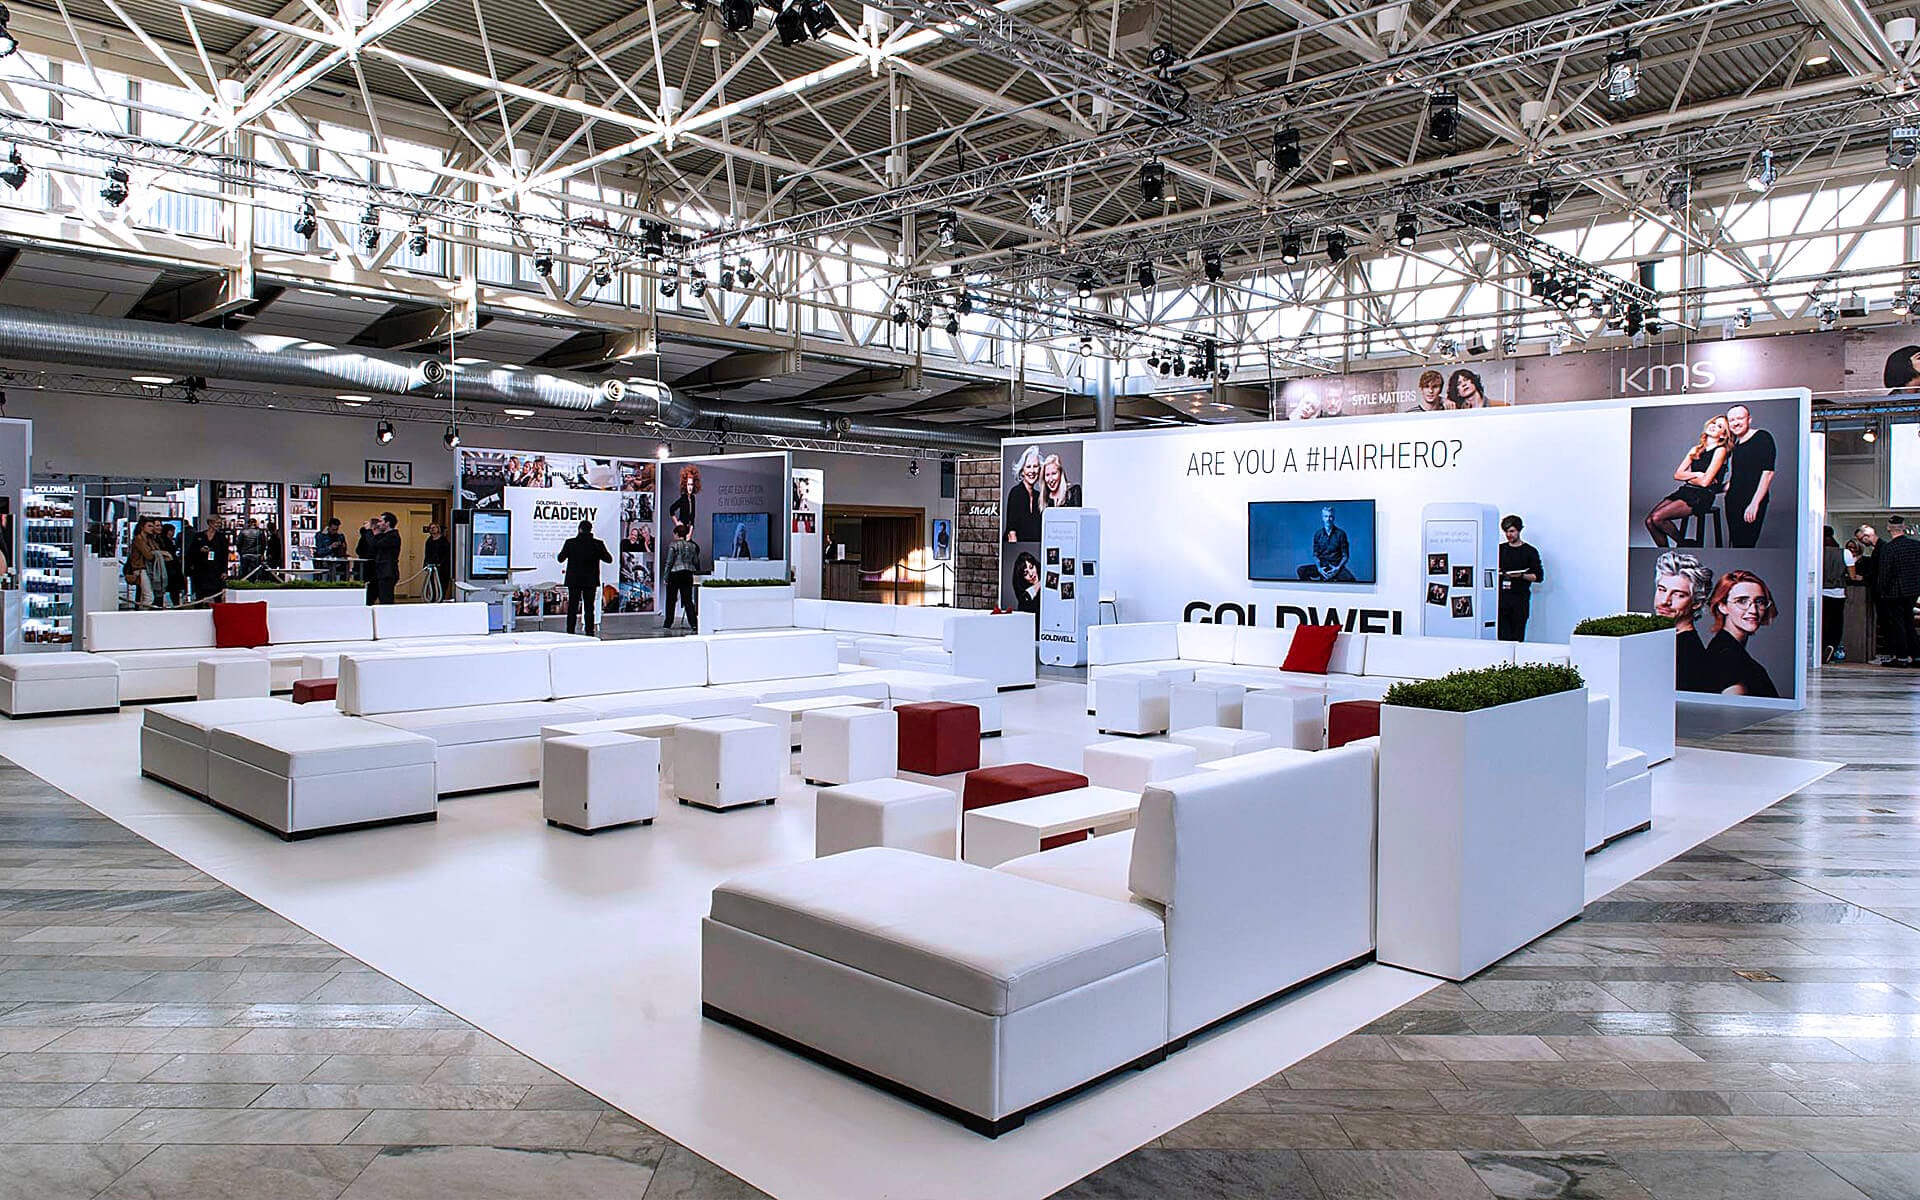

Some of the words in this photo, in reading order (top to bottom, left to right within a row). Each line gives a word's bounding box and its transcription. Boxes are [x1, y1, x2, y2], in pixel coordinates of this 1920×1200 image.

[1620, 361, 1716, 393] kms
[1352, 393, 1377, 406] STYLE
[1379, 391, 1417, 404] MATTERS
[1186, 451, 1225, 477] ARE
[1233, 448, 1276, 475] YOU
[1283, 447, 1298, 473] A
[1306, 439, 1463, 472] #HAIRHERO?
[34, 486, 78, 494] GOLDWELL
[533, 505, 598, 521] ACADEMY
[969, 502, 998, 516] sneak
[1041, 633, 1077, 643] GOLDWELL
